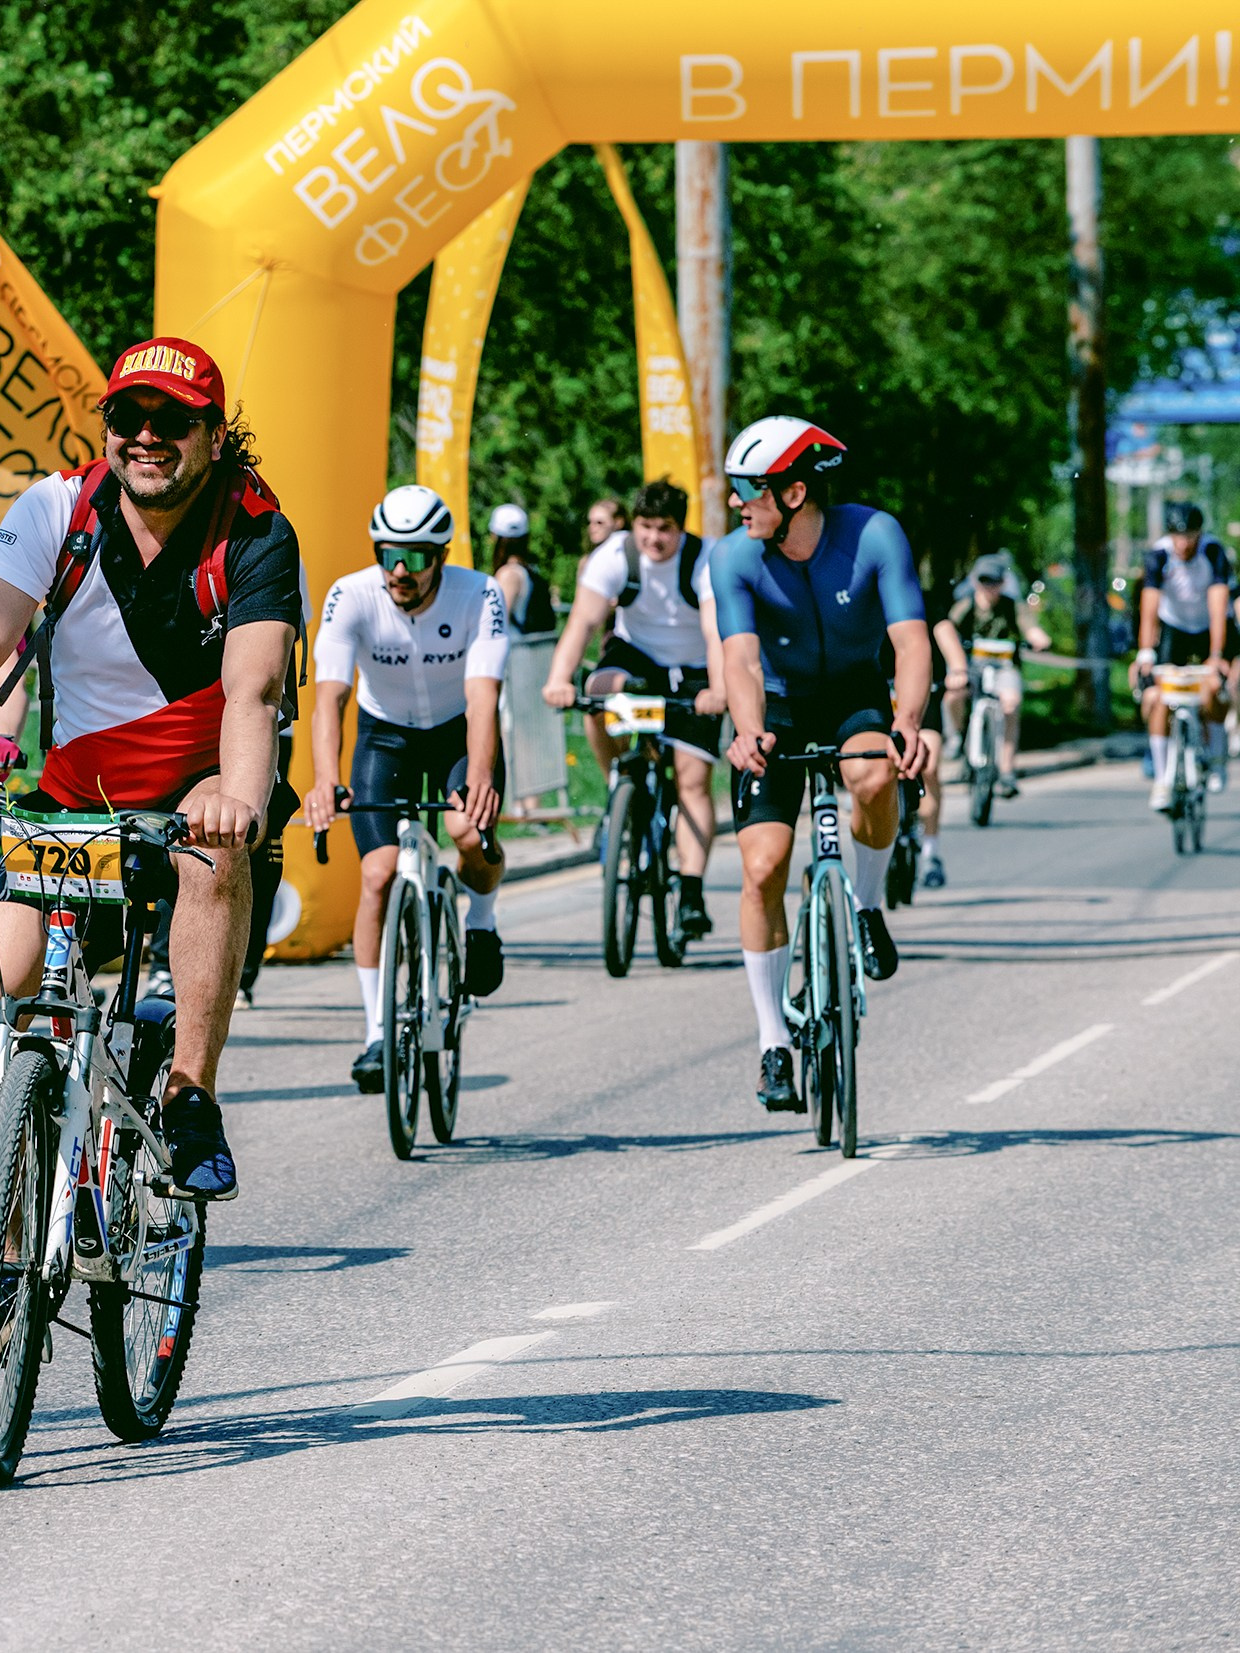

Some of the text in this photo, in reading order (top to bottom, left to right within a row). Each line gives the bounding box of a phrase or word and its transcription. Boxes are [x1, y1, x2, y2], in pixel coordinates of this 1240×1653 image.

[263, 15, 432, 175] ПЕРМСКИЙ
[680, 30, 1232, 122] В ПЕРМИ!
[119, 345, 197, 381] MARINES
[820, 813, 839, 853] 015
[27, 843, 91, 876] 720
